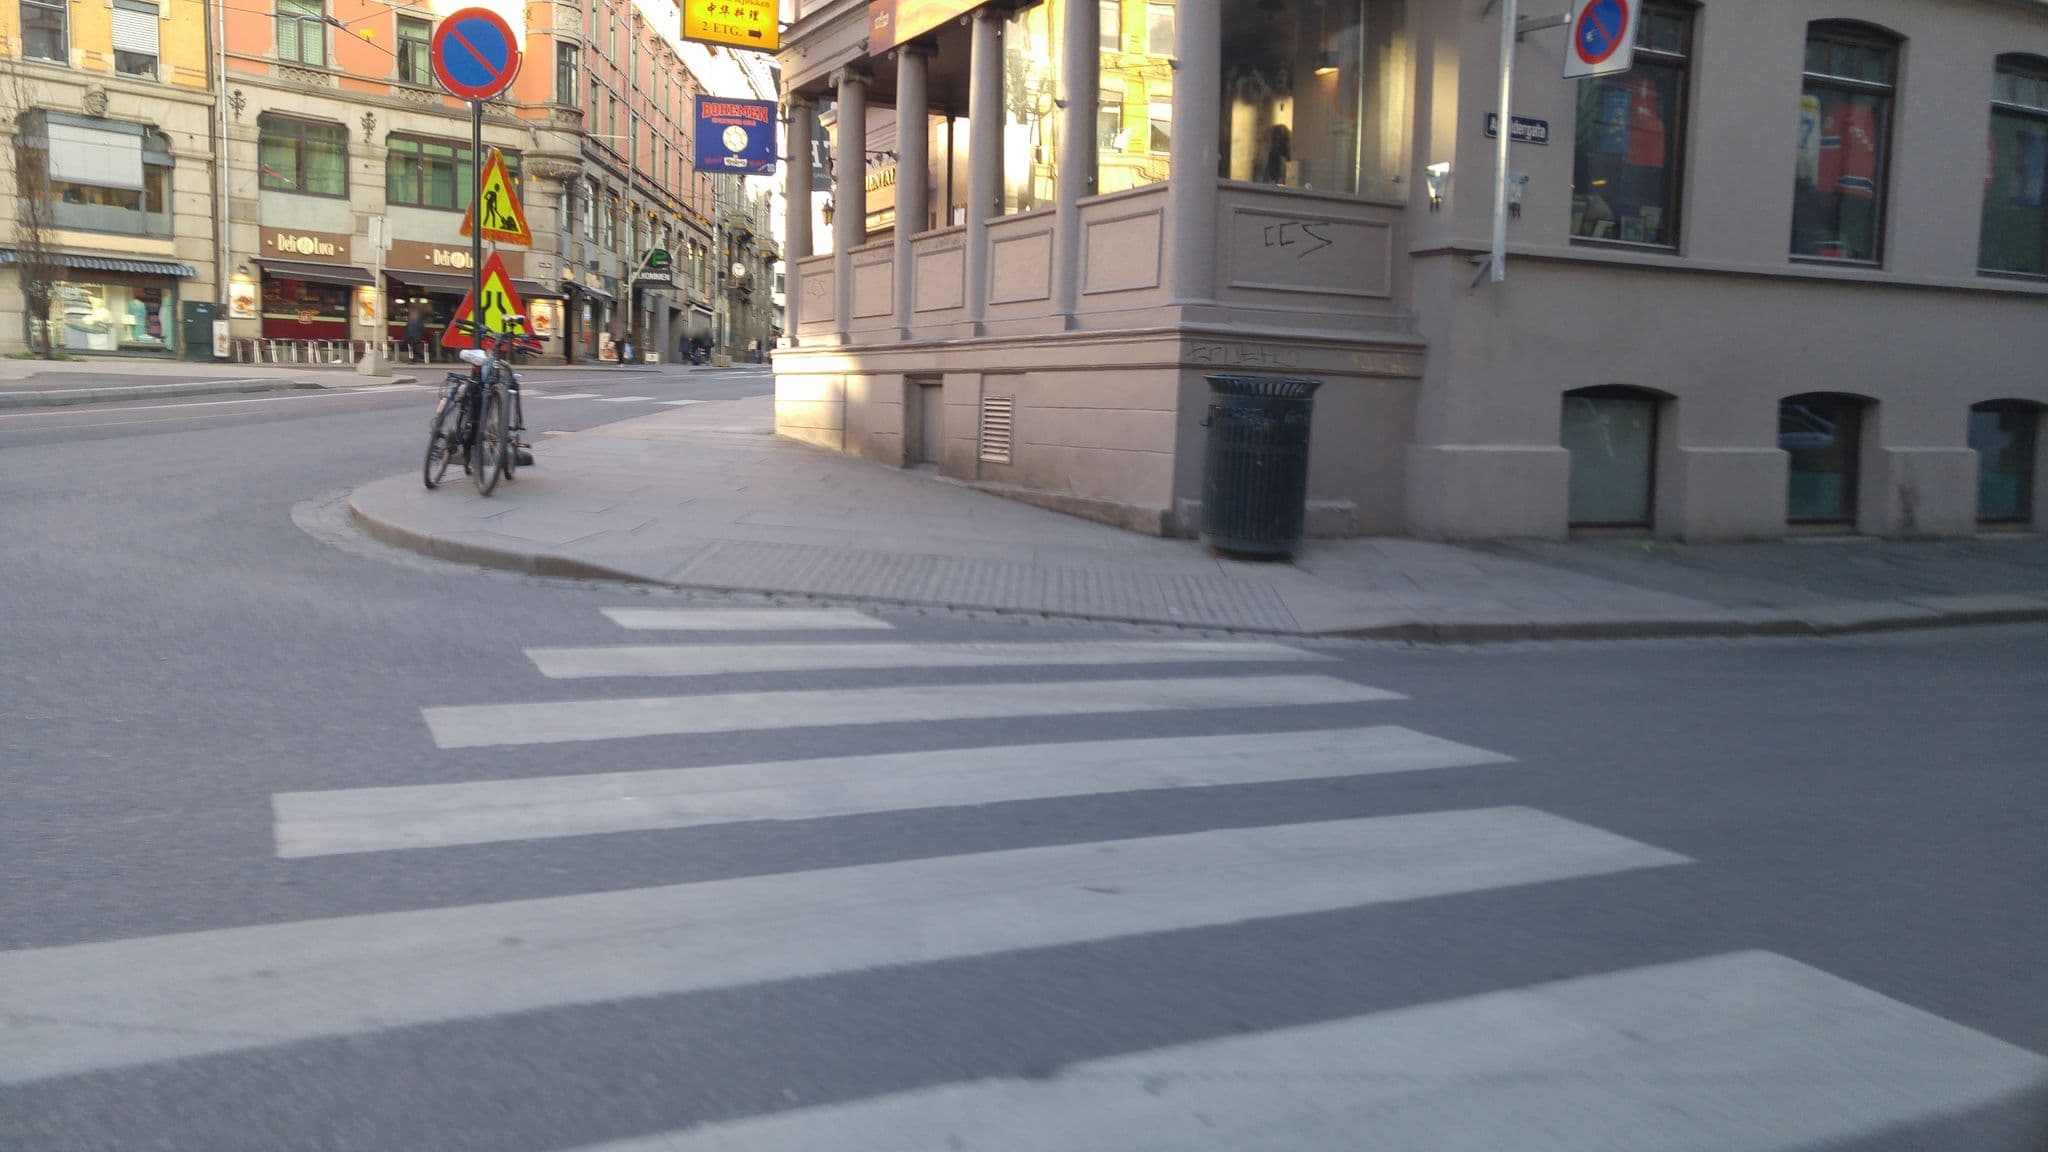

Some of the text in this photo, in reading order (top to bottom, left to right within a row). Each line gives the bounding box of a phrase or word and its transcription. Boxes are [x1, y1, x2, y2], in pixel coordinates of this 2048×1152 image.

[702, 21, 708, 31] 2
[702, 101, 769, 124] BOHEMEN
[277, 233, 297, 252] Deli
[314, 236, 335, 256] Luca
